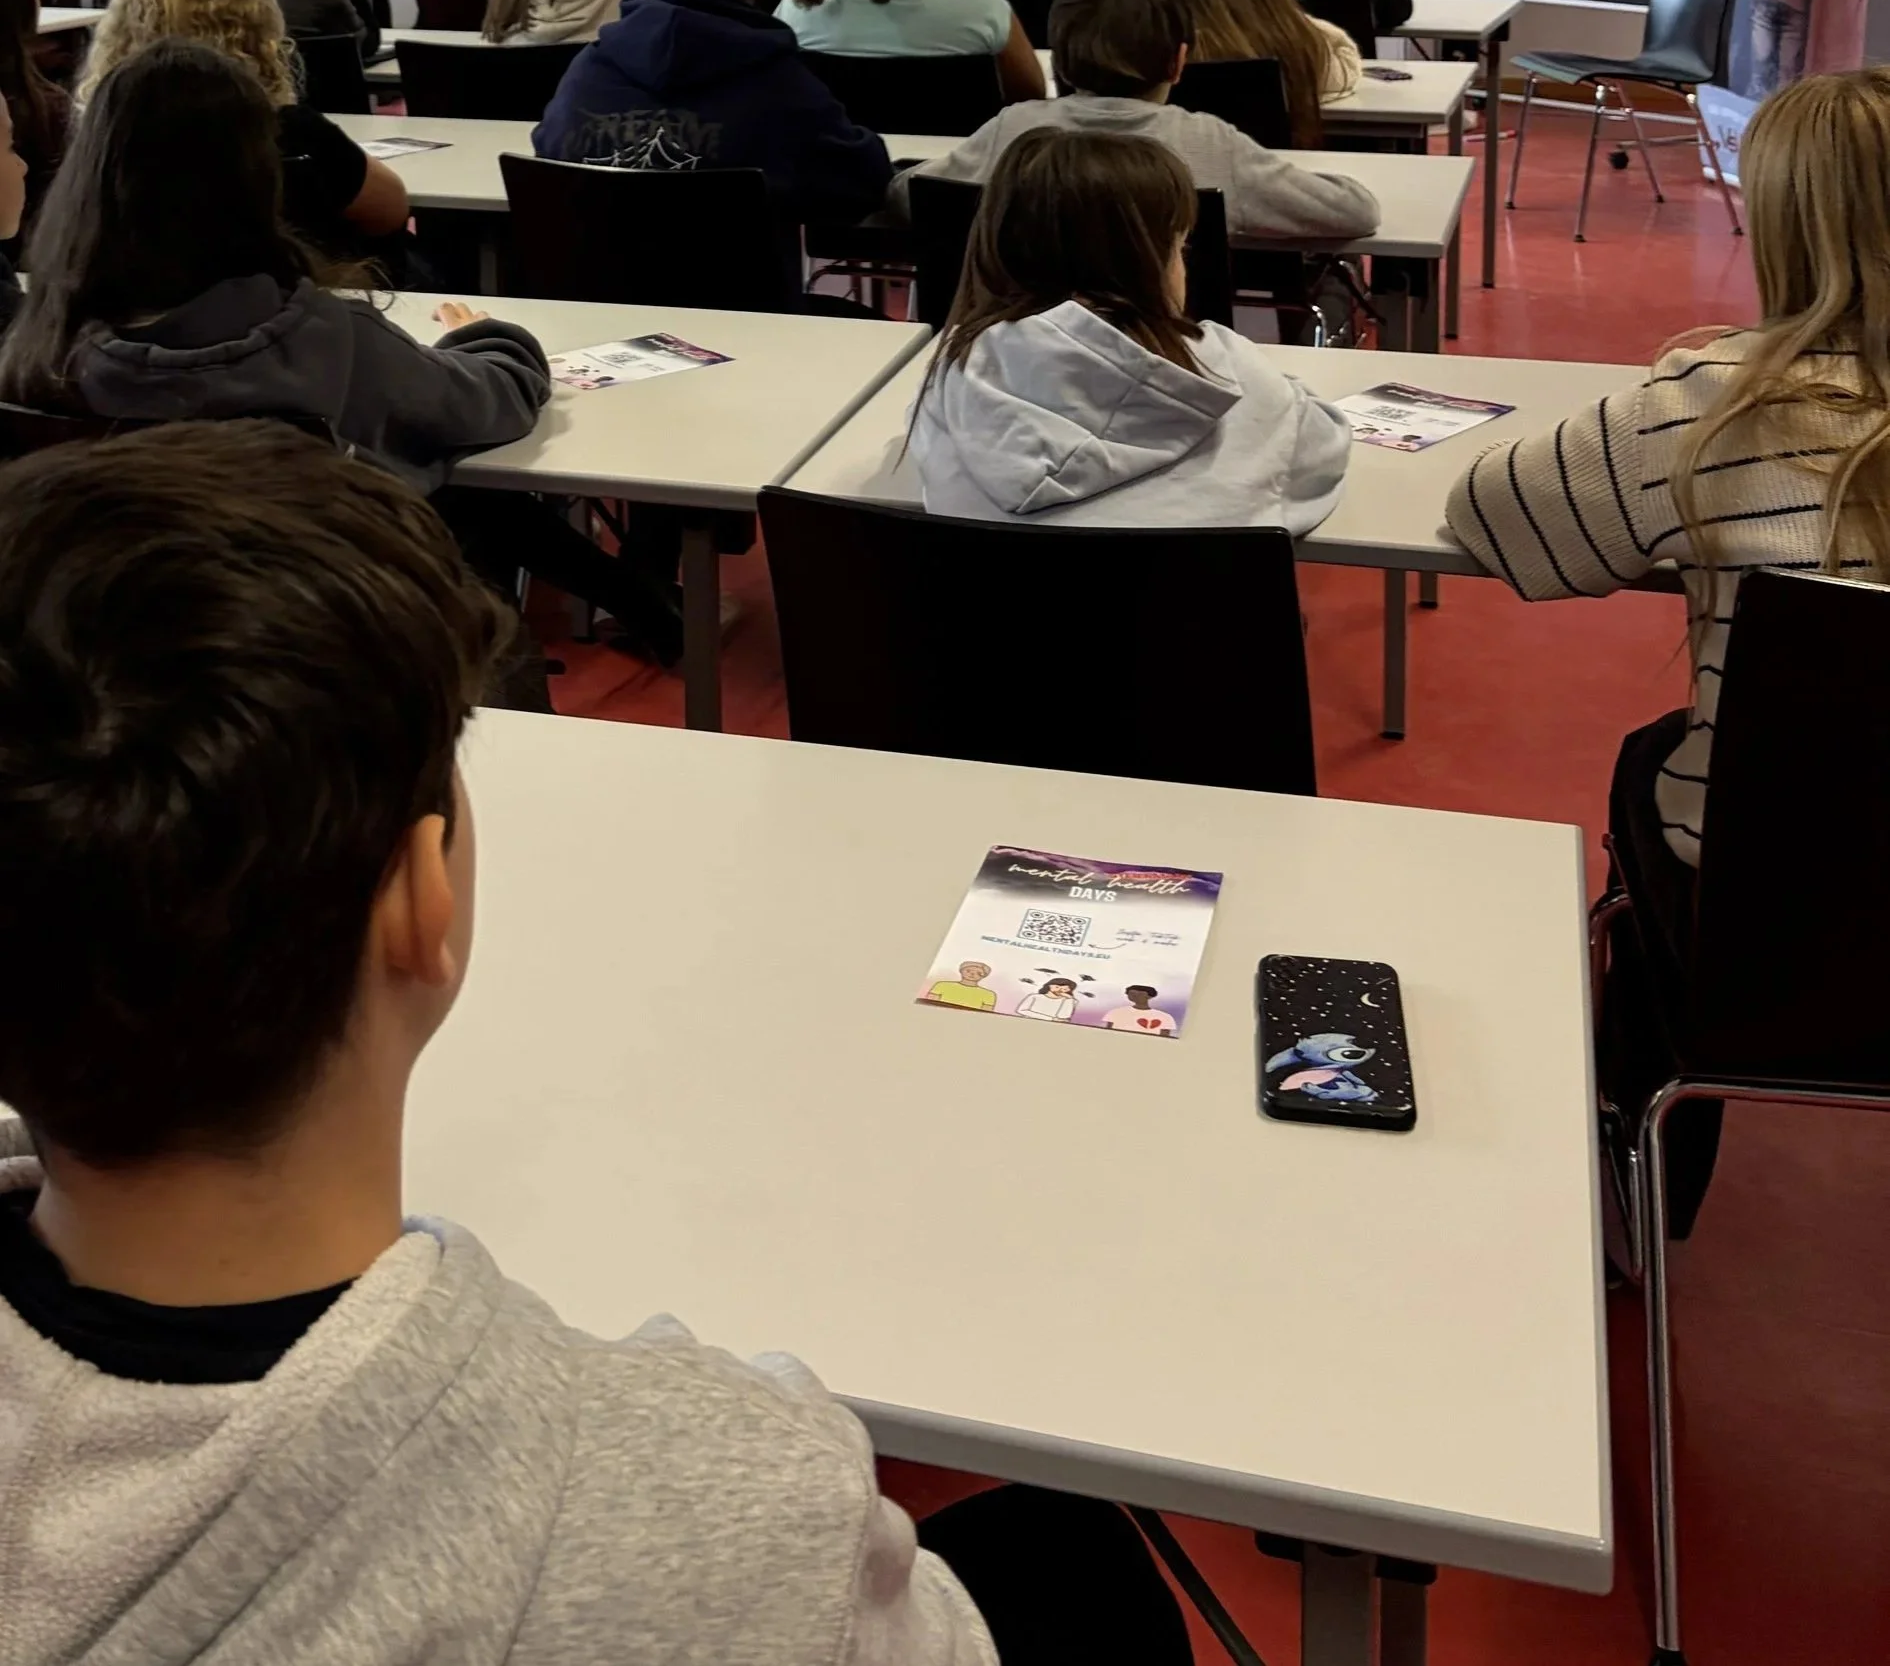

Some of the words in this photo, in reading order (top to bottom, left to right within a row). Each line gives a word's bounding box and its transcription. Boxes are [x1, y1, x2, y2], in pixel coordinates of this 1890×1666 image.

[1008, 863, 1095, 885] mental
[1106, 873, 1191, 895] health
[1068, 885, 1117, 902] DAYS
